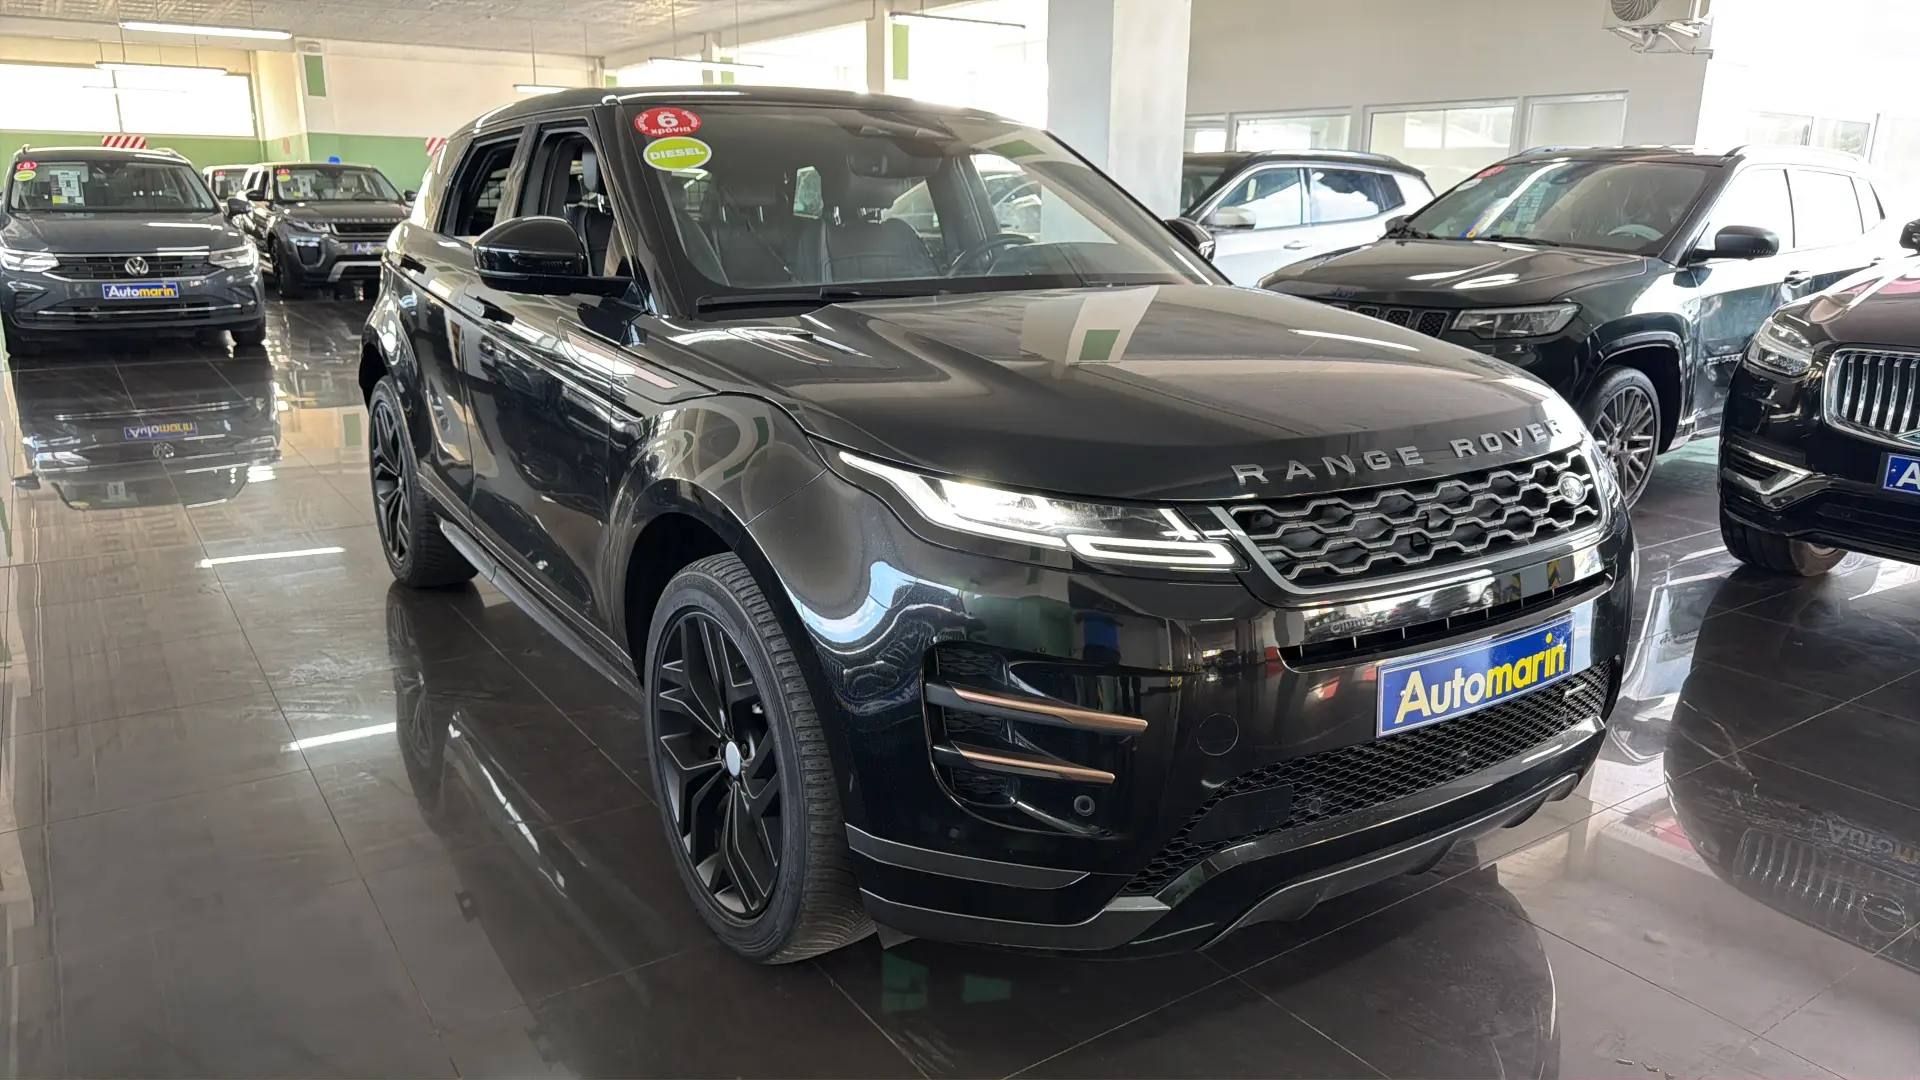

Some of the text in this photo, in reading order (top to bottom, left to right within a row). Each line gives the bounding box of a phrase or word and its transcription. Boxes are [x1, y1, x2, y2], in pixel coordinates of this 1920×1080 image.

[657, 112, 679, 128] 6
[649, 147, 705, 161] DIESEL
[108, 284, 175, 297] Automarin
[1231, 419, 1563, 486] RANGE ROVER
[1394, 632, 1567, 724] Automarin
